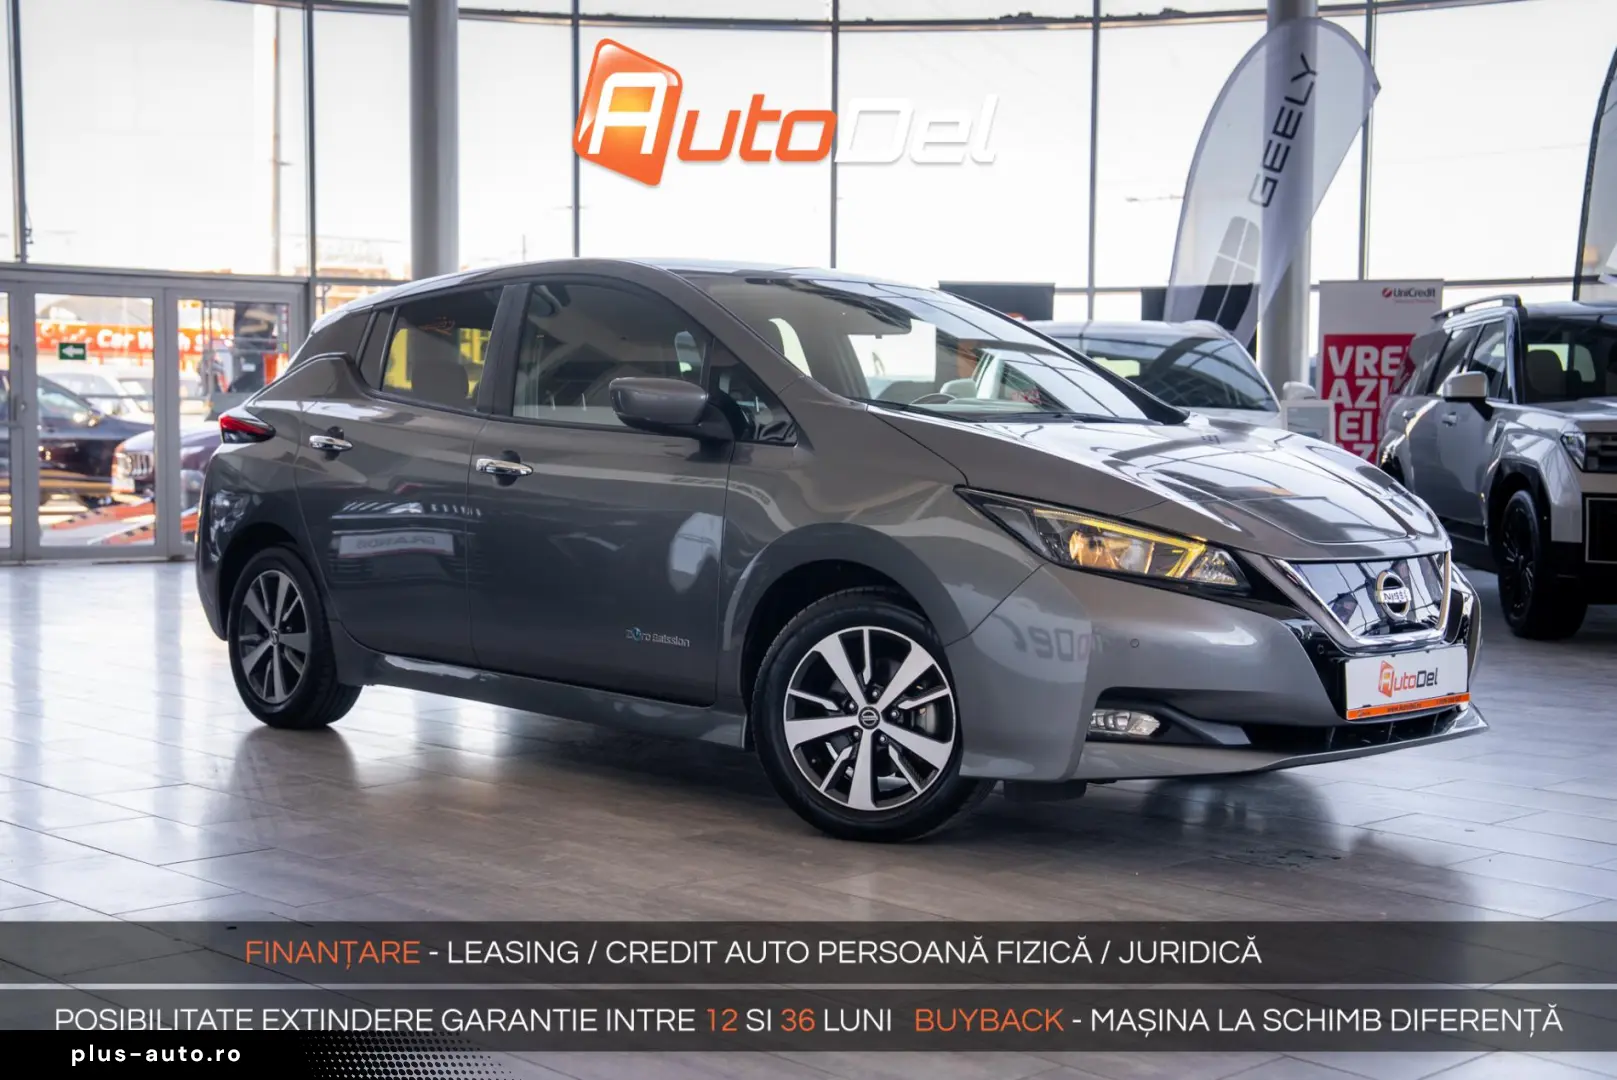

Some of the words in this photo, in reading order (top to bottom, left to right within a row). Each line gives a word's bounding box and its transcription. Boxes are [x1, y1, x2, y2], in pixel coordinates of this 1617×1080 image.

[1249, 52, 1319, 208] GEELY
[1327, 345, 1409, 377] VRE
[1380, 663, 1438, 693] AutoDel
